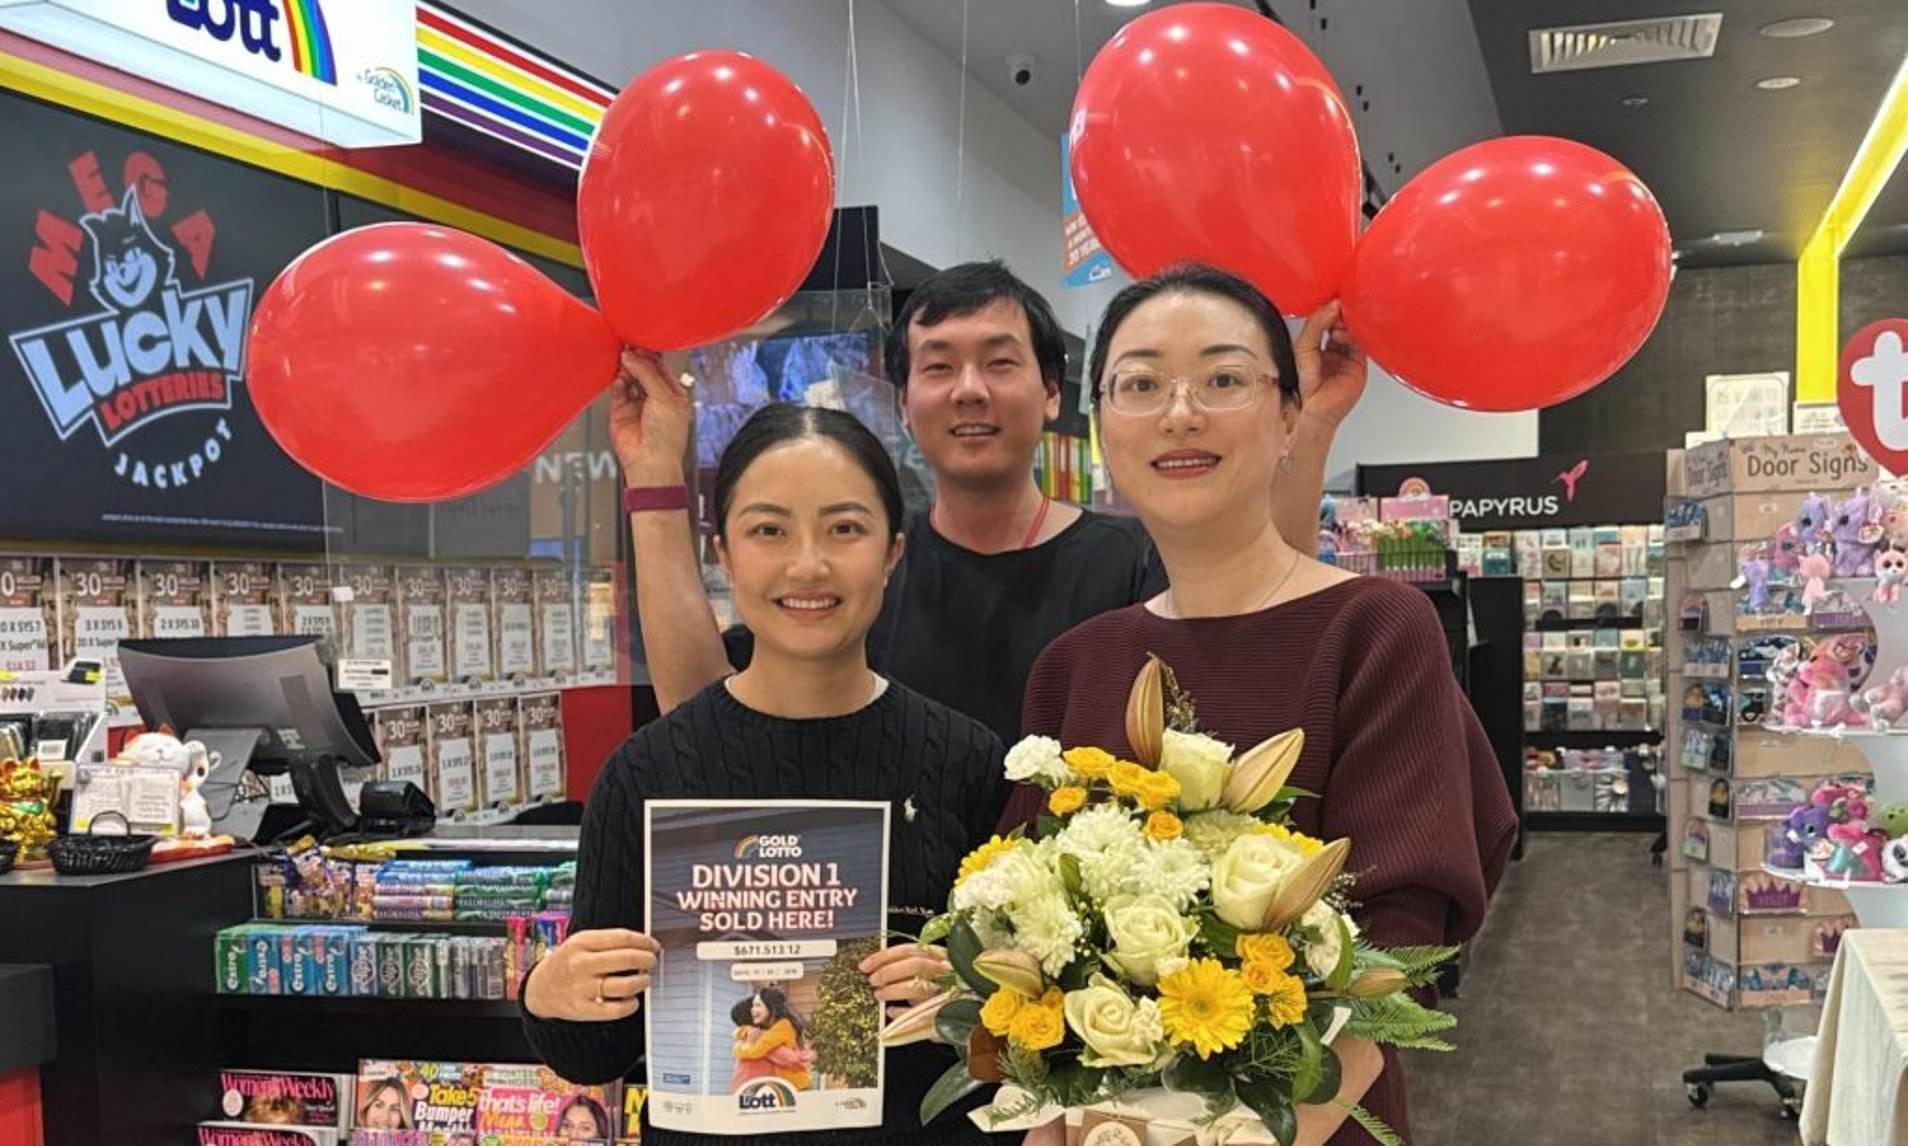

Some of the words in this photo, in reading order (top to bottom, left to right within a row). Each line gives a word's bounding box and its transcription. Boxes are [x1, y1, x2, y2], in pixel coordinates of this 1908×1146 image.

[100, 371, 225, 431] LOTTERIES
[114, 417, 232, 488] JACKPOT
[1747, 454, 1800, 477] Door
[1809, 451, 1868, 480] Signs
[1449, 496, 1558, 517] PAPYRUS
[75, 571, 101, 597] 30
[156, 573, 179, 597] 30
[227, 572, 250, 596] 30
[293, 575, 315, 597] 30
[352, 575, 373, 596] 30
[438, 713, 455, 733] 30
[485, 708, 501, 728] 30
[389, 720, 406, 740] 30
[759, 835, 798, 847] GOLD
[759, 847, 802, 858] LOTTO
[692, 863, 821, 888] DIVISION
[826, 863, 841, 886] 1
[676, 890, 780, 910] WINNING
[786, 888, 858, 909] ENTRY
[700, 912, 763, 931] SOLD
[768, 910, 834, 930] HERE!
[414, 1101, 474, 1126] Bumper
